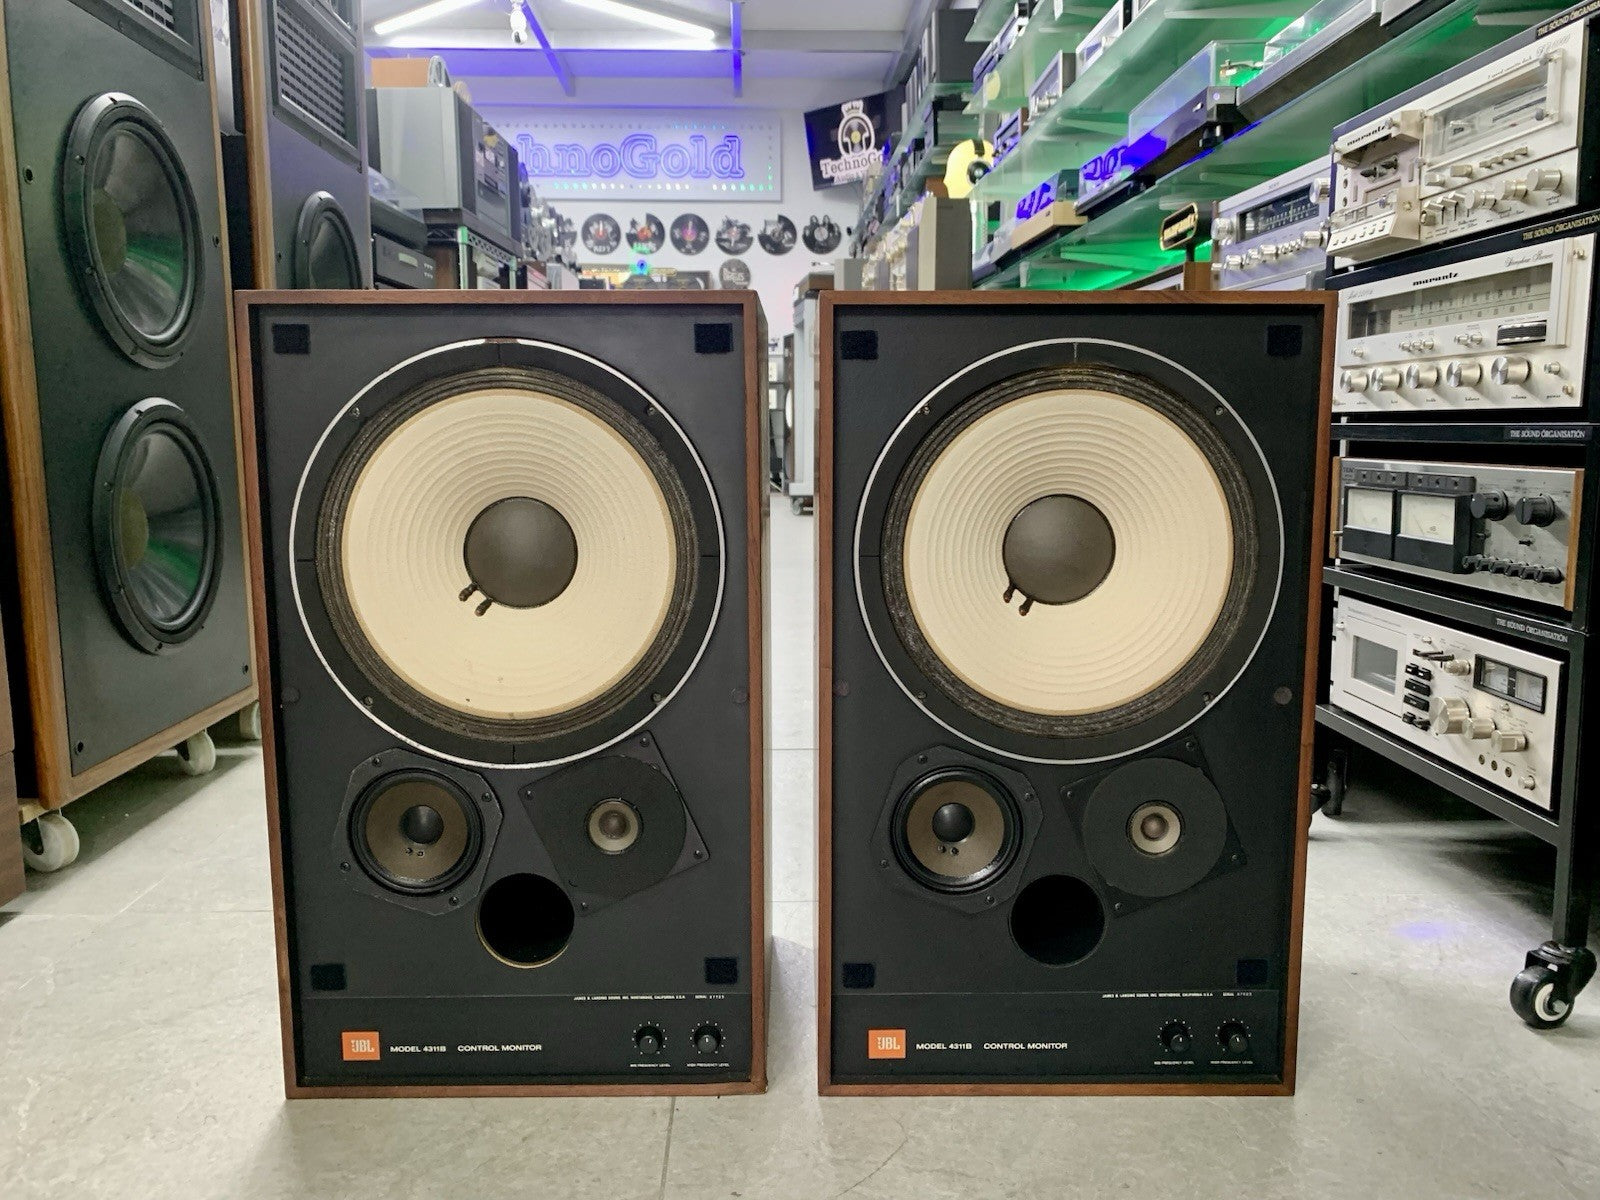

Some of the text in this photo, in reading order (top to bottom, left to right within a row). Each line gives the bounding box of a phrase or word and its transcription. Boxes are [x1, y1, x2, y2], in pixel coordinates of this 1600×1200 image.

[1549, 15, 1569, 31] SOUND
[516, 133, 744, 178] hnoGold
[1523, 232, 1533, 240] THE
[1534, 227, 1554, 238] SOUND
[1413, 272, 1458, 286] marantz
[1510, 429, 1585, 438] THE SOUND ORGANISATION
[1496, 618, 1568, 642] THE SOUND ORGANISATION
[351, 1039, 374, 1053] JBL
[390, 1045, 421, 1053] MODEL
[423, 1045, 446, 1053] 4311B
[457, 1044, 500, 1052] CONTROL
[877, 1036, 901, 1051] JBL
[916, 1042, 947, 1050] MODEL
[948, 1042, 972, 1050] 4311B
[983, 1042, 1026, 1050] CONTROL
